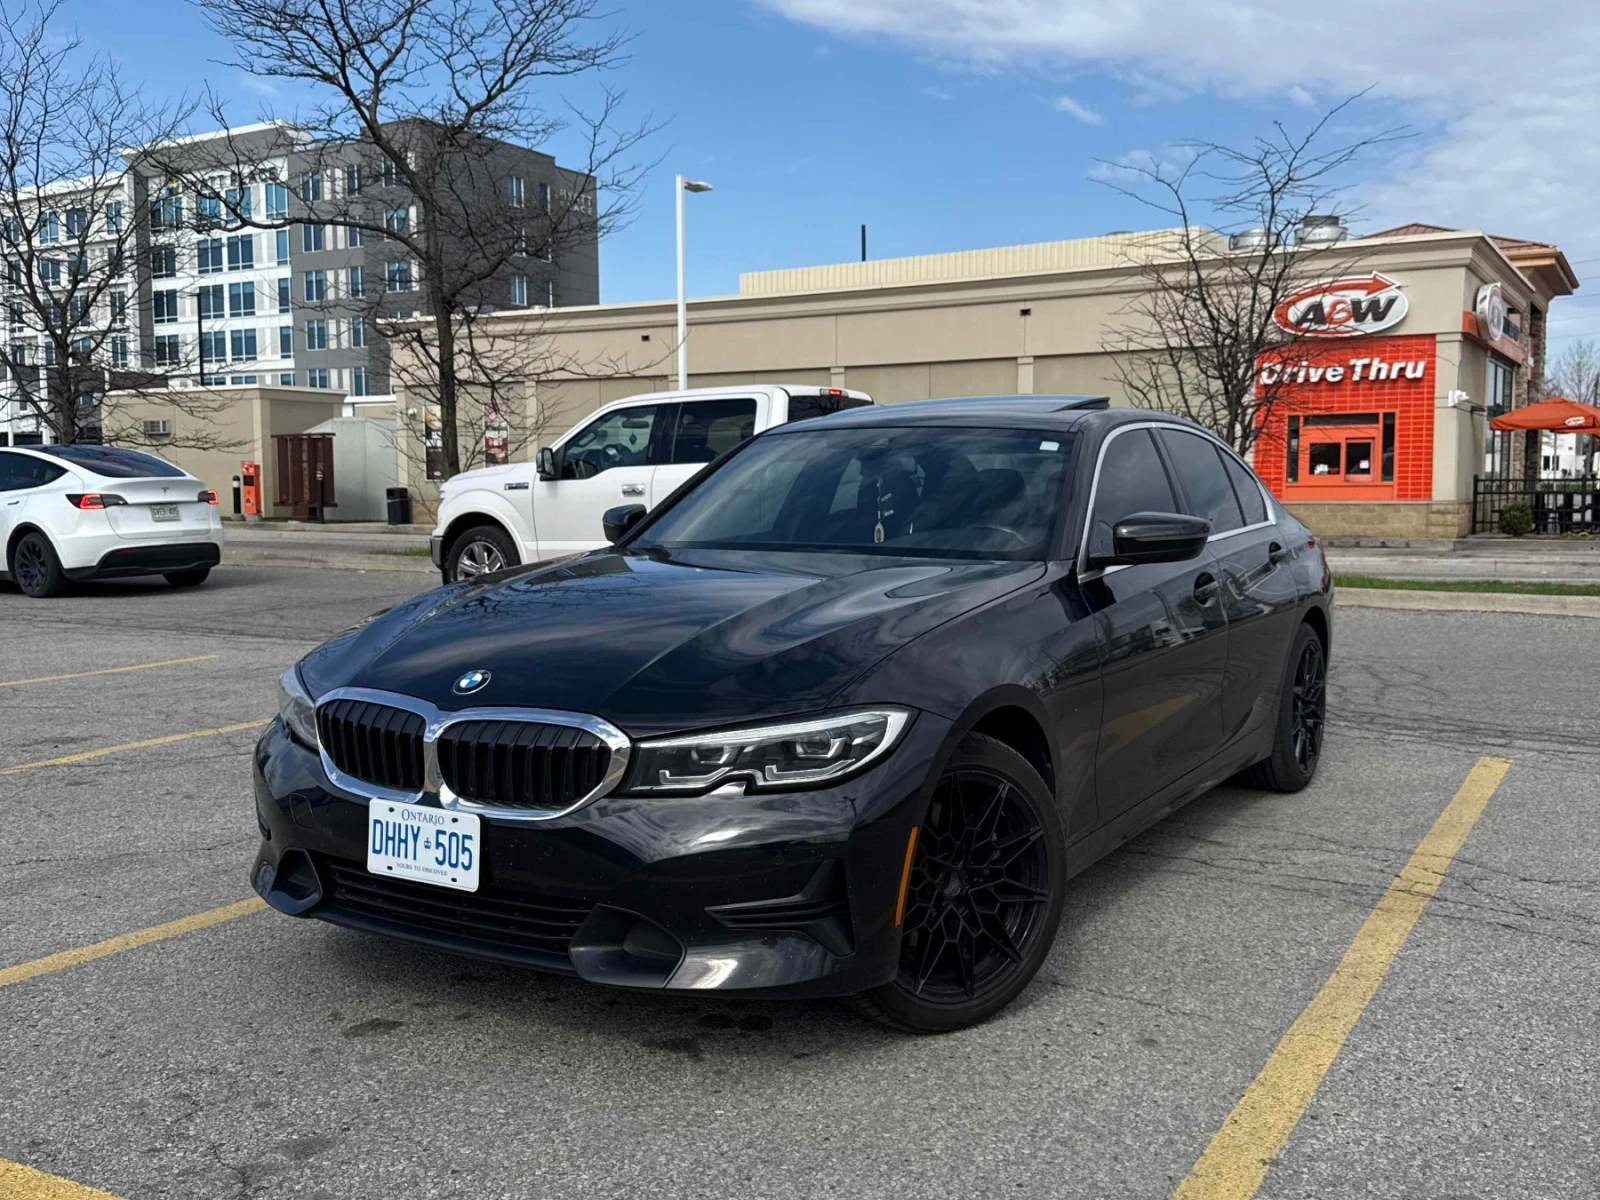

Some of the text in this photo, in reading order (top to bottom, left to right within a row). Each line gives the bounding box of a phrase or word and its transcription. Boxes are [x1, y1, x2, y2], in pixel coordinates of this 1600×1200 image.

[1294, 295, 1399, 326] A&W
[1259, 357, 1426, 385] Drive Thru
[401, 808, 445, 826] ONTARIO
[371, 818, 473, 871] DHHY 505
[395, 862, 413, 870] YOURS
[422, 867, 448, 877] DISCOVER
